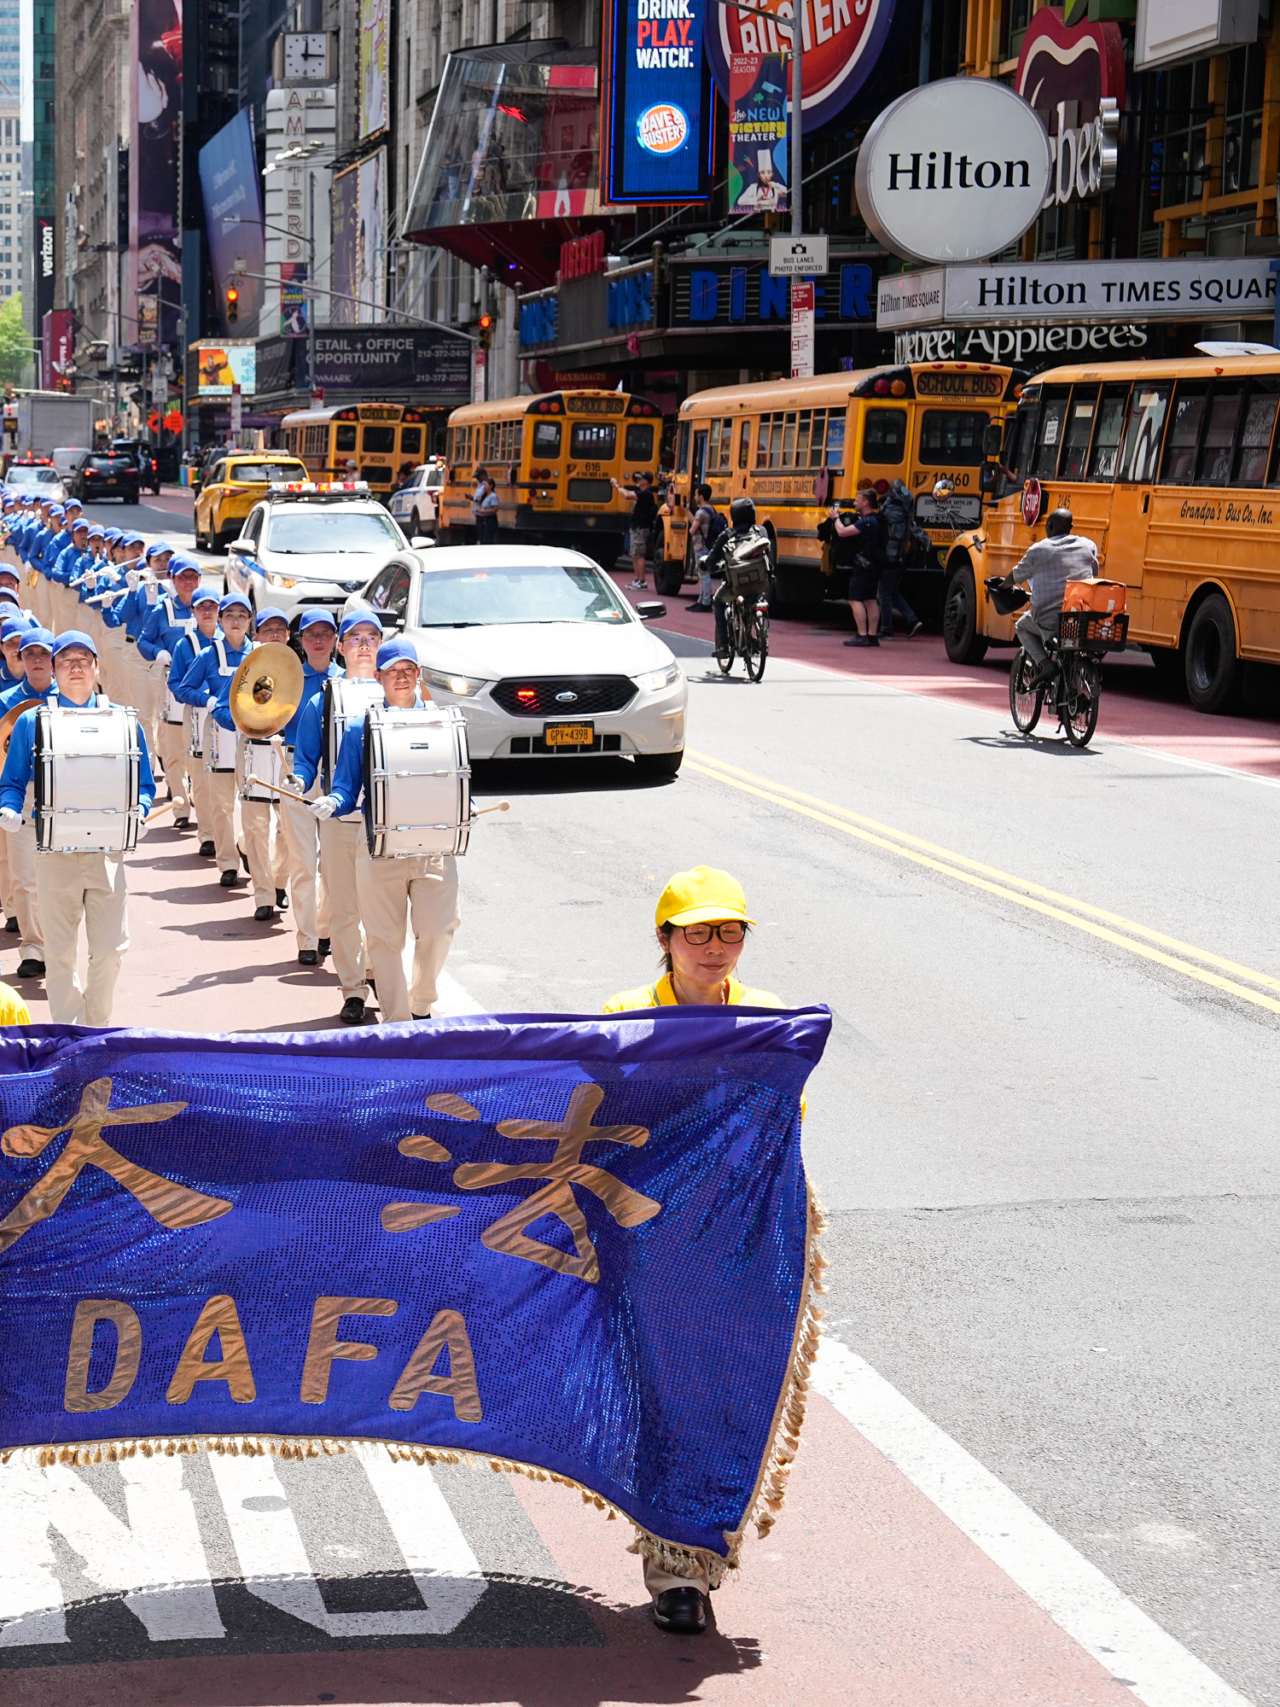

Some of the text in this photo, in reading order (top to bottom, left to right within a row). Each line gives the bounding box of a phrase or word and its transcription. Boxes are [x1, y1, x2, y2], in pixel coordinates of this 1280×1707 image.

[638, 20, 694, 47] PLAY.
[642, 111, 672, 132] DAVE
[747, 107, 780, 121] NEW
[731, 132, 776, 142] THEATER
[888, 151, 1031, 191] Hilton
[40, 226, 54, 278] verizon
[880, 289, 940, 314] Hilton TIMES SQUARE
[977, 276, 1087, 306] Hilton
[1101, 280, 1181, 302] TIMES
[365, 338, 415, 350] OFFICE
[918, 374, 997, 394] SCHOOL BUS
[569, 399, 624, 414] SCHOOL BUS
[585, 462, 601, 472] 616
[1025, 493, 1039, 511] STOP
[1180, 500, 1222, 525] Grandpa's
[1225, 503, 1241, 523] Bus
[1257, 504, 1273, 525] Inc.
[64, 1294, 483, 1424] DAFA
